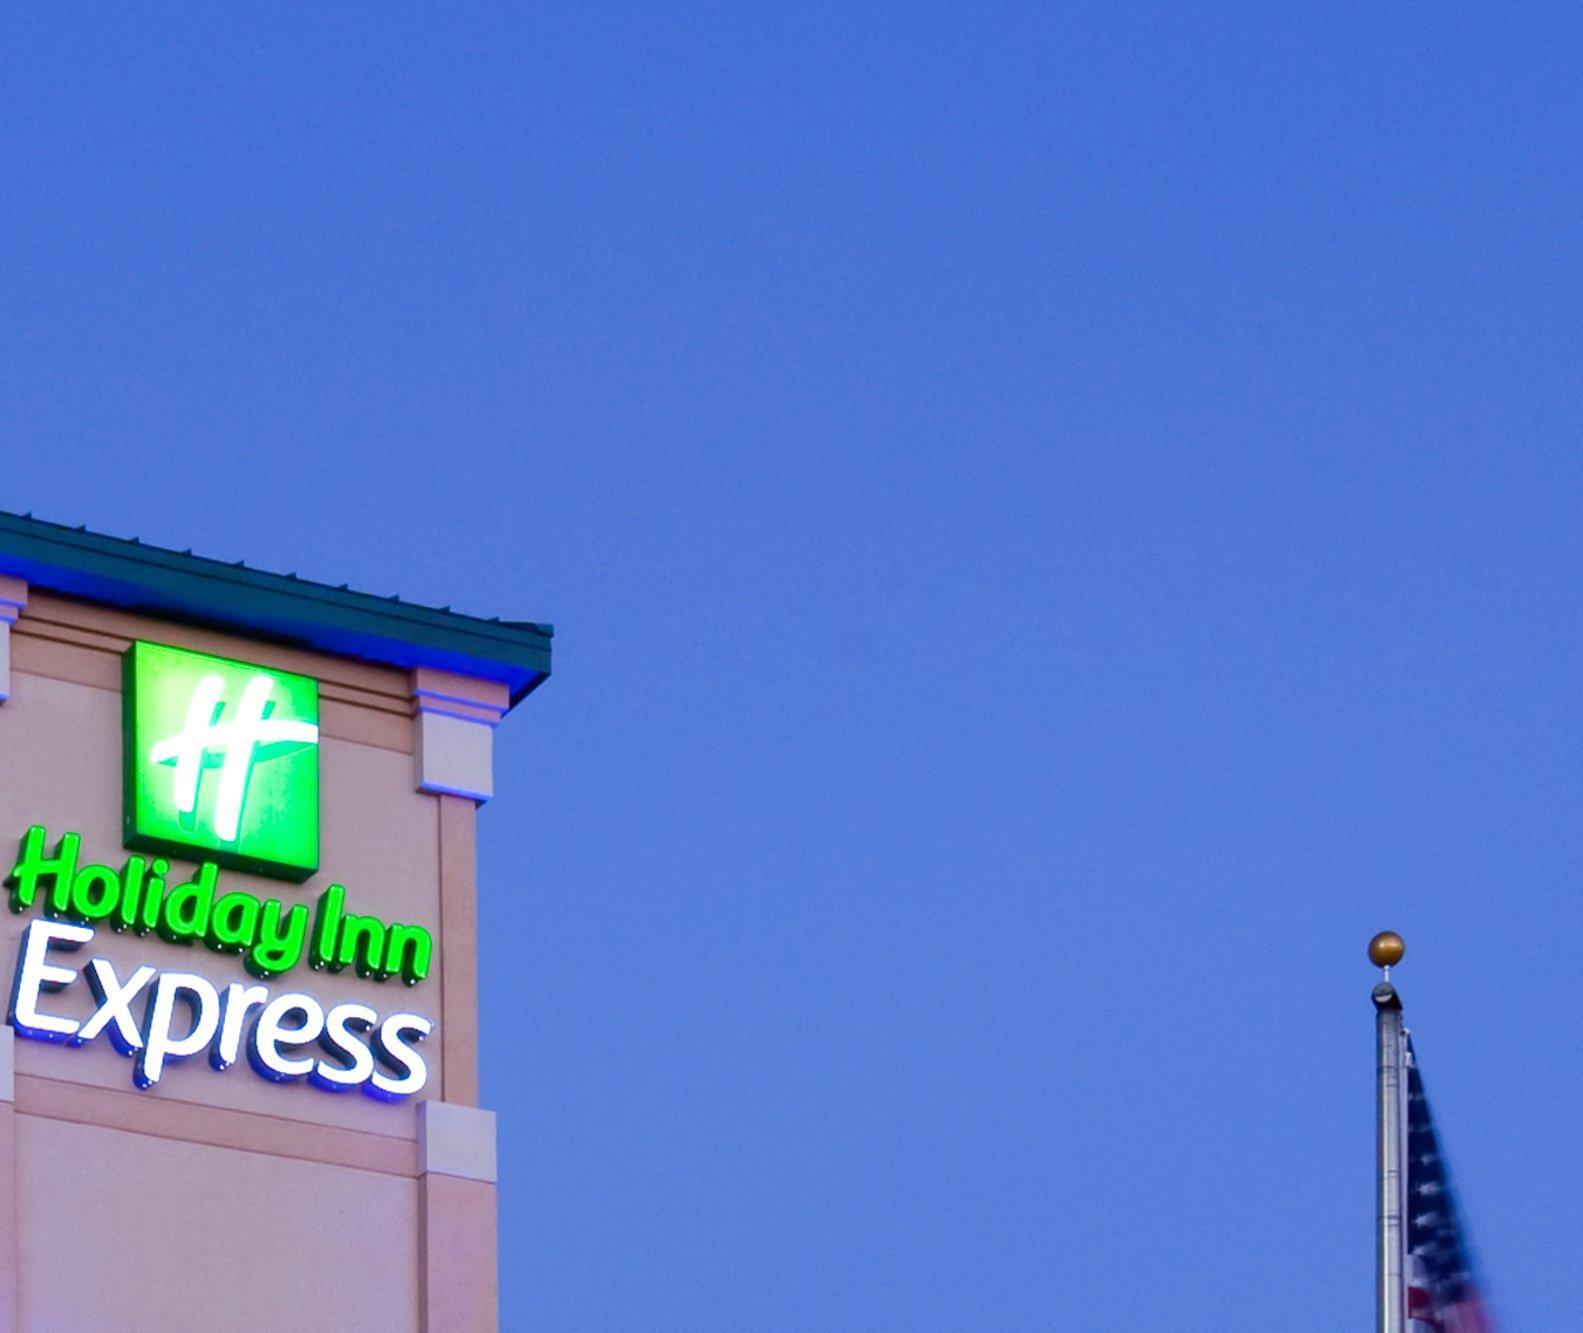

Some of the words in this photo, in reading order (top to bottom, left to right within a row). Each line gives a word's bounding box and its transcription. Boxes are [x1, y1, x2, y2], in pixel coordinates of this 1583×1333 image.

[8, 825, 309, 976] Holiday
[314, 883, 433, 981] Inn
[12, 918, 434, 1096] Express
